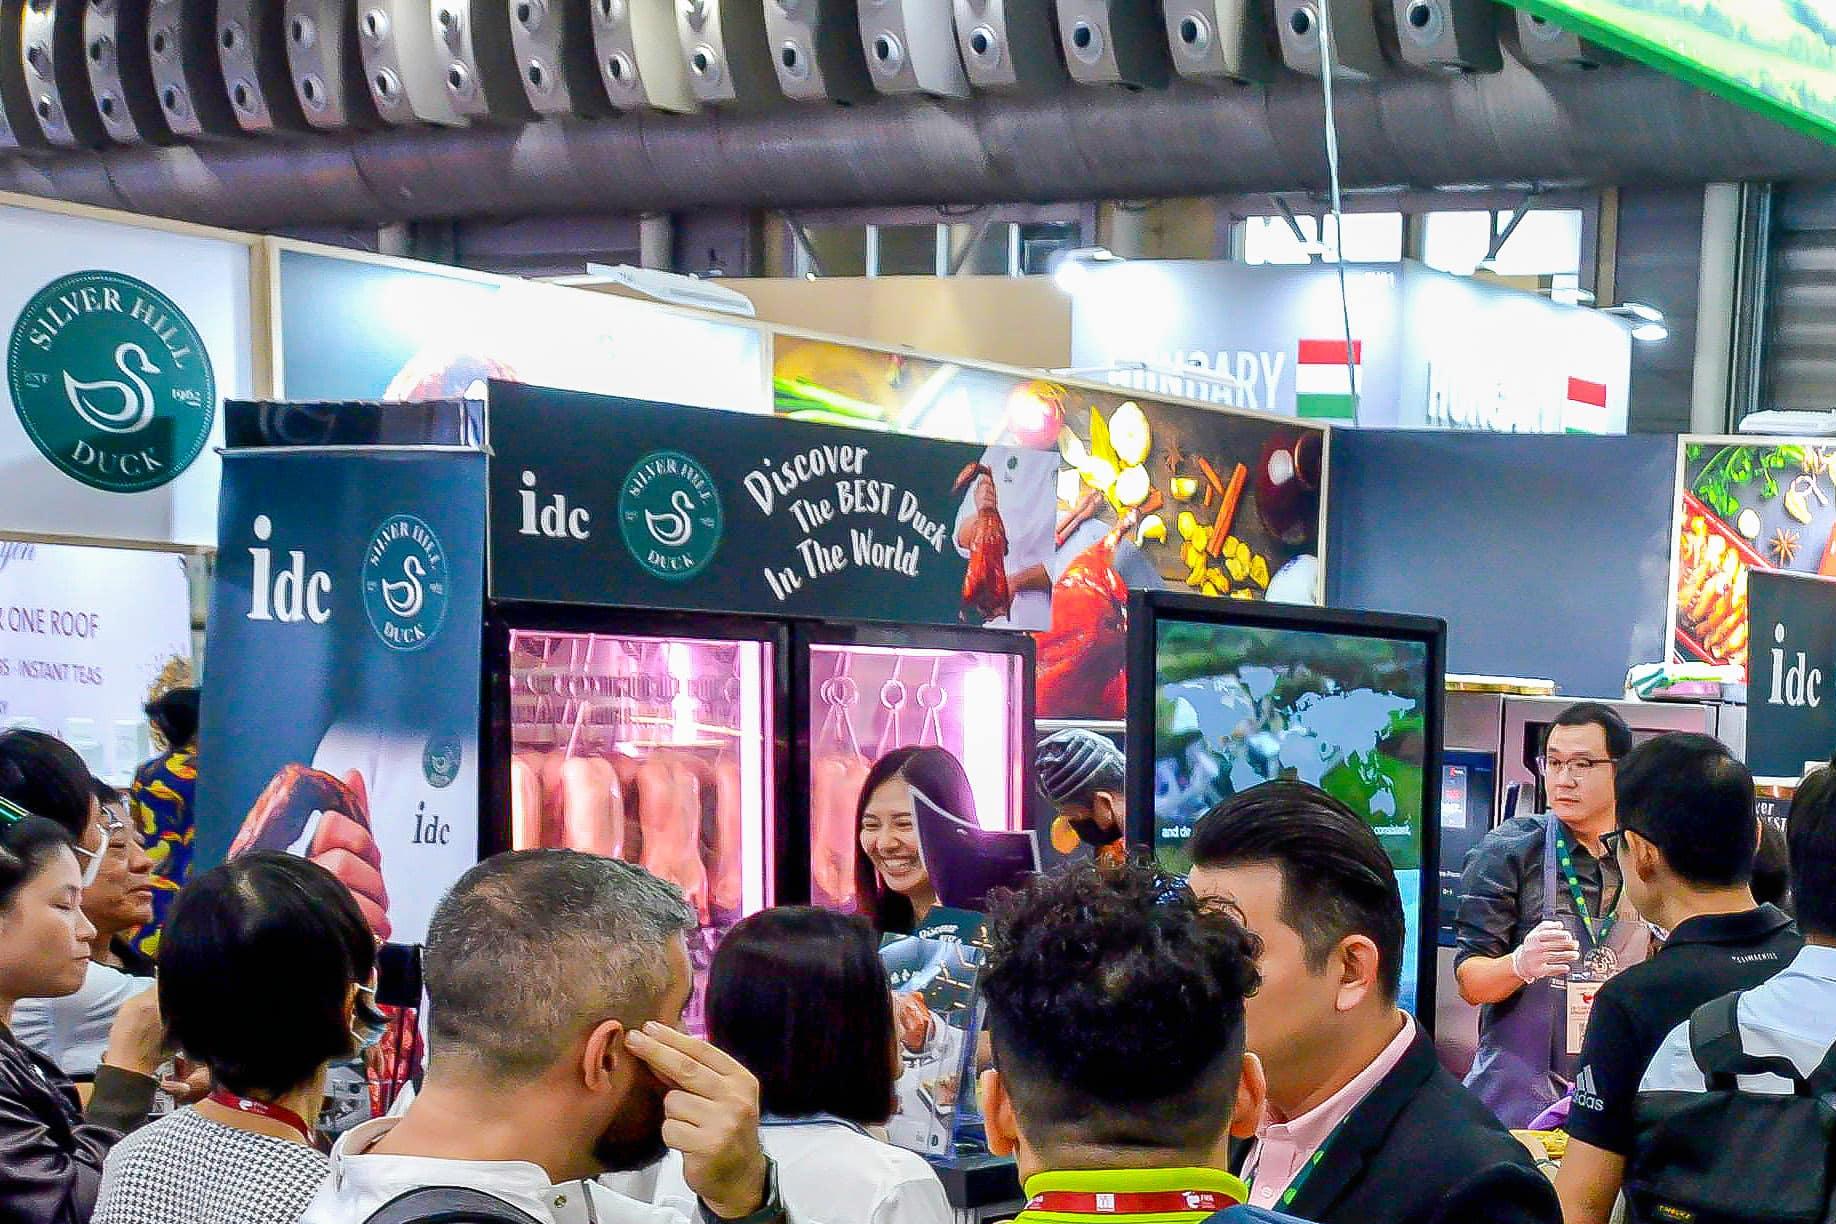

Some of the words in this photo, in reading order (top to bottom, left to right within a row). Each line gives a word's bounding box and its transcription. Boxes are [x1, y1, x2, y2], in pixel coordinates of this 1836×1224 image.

[29, 287, 123, 351] SILVER
[129, 297, 191, 369] HILL
[71, 440, 162, 476] DUCK
[744, 445, 868, 516] Discover
[518, 470, 590, 540] idc
[789, 499, 835, 534] The
[835, 479, 896, 516] BEST
[898, 490, 947, 552] Duck
[247, 514, 332, 624] idc
[764, 567, 804, 601] In
[796, 538, 849, 579] The
[850, 528, 920, 578] World
[8, 607, 46, 634] ONE
[50, 610, 99, 638] ROOF
[19, 660, 69, 682] INSTANT
[72, 664, 103, 686] TEAS
[1768, 623, 1822, 708] idc
[412, 800, 451, 845] idc
